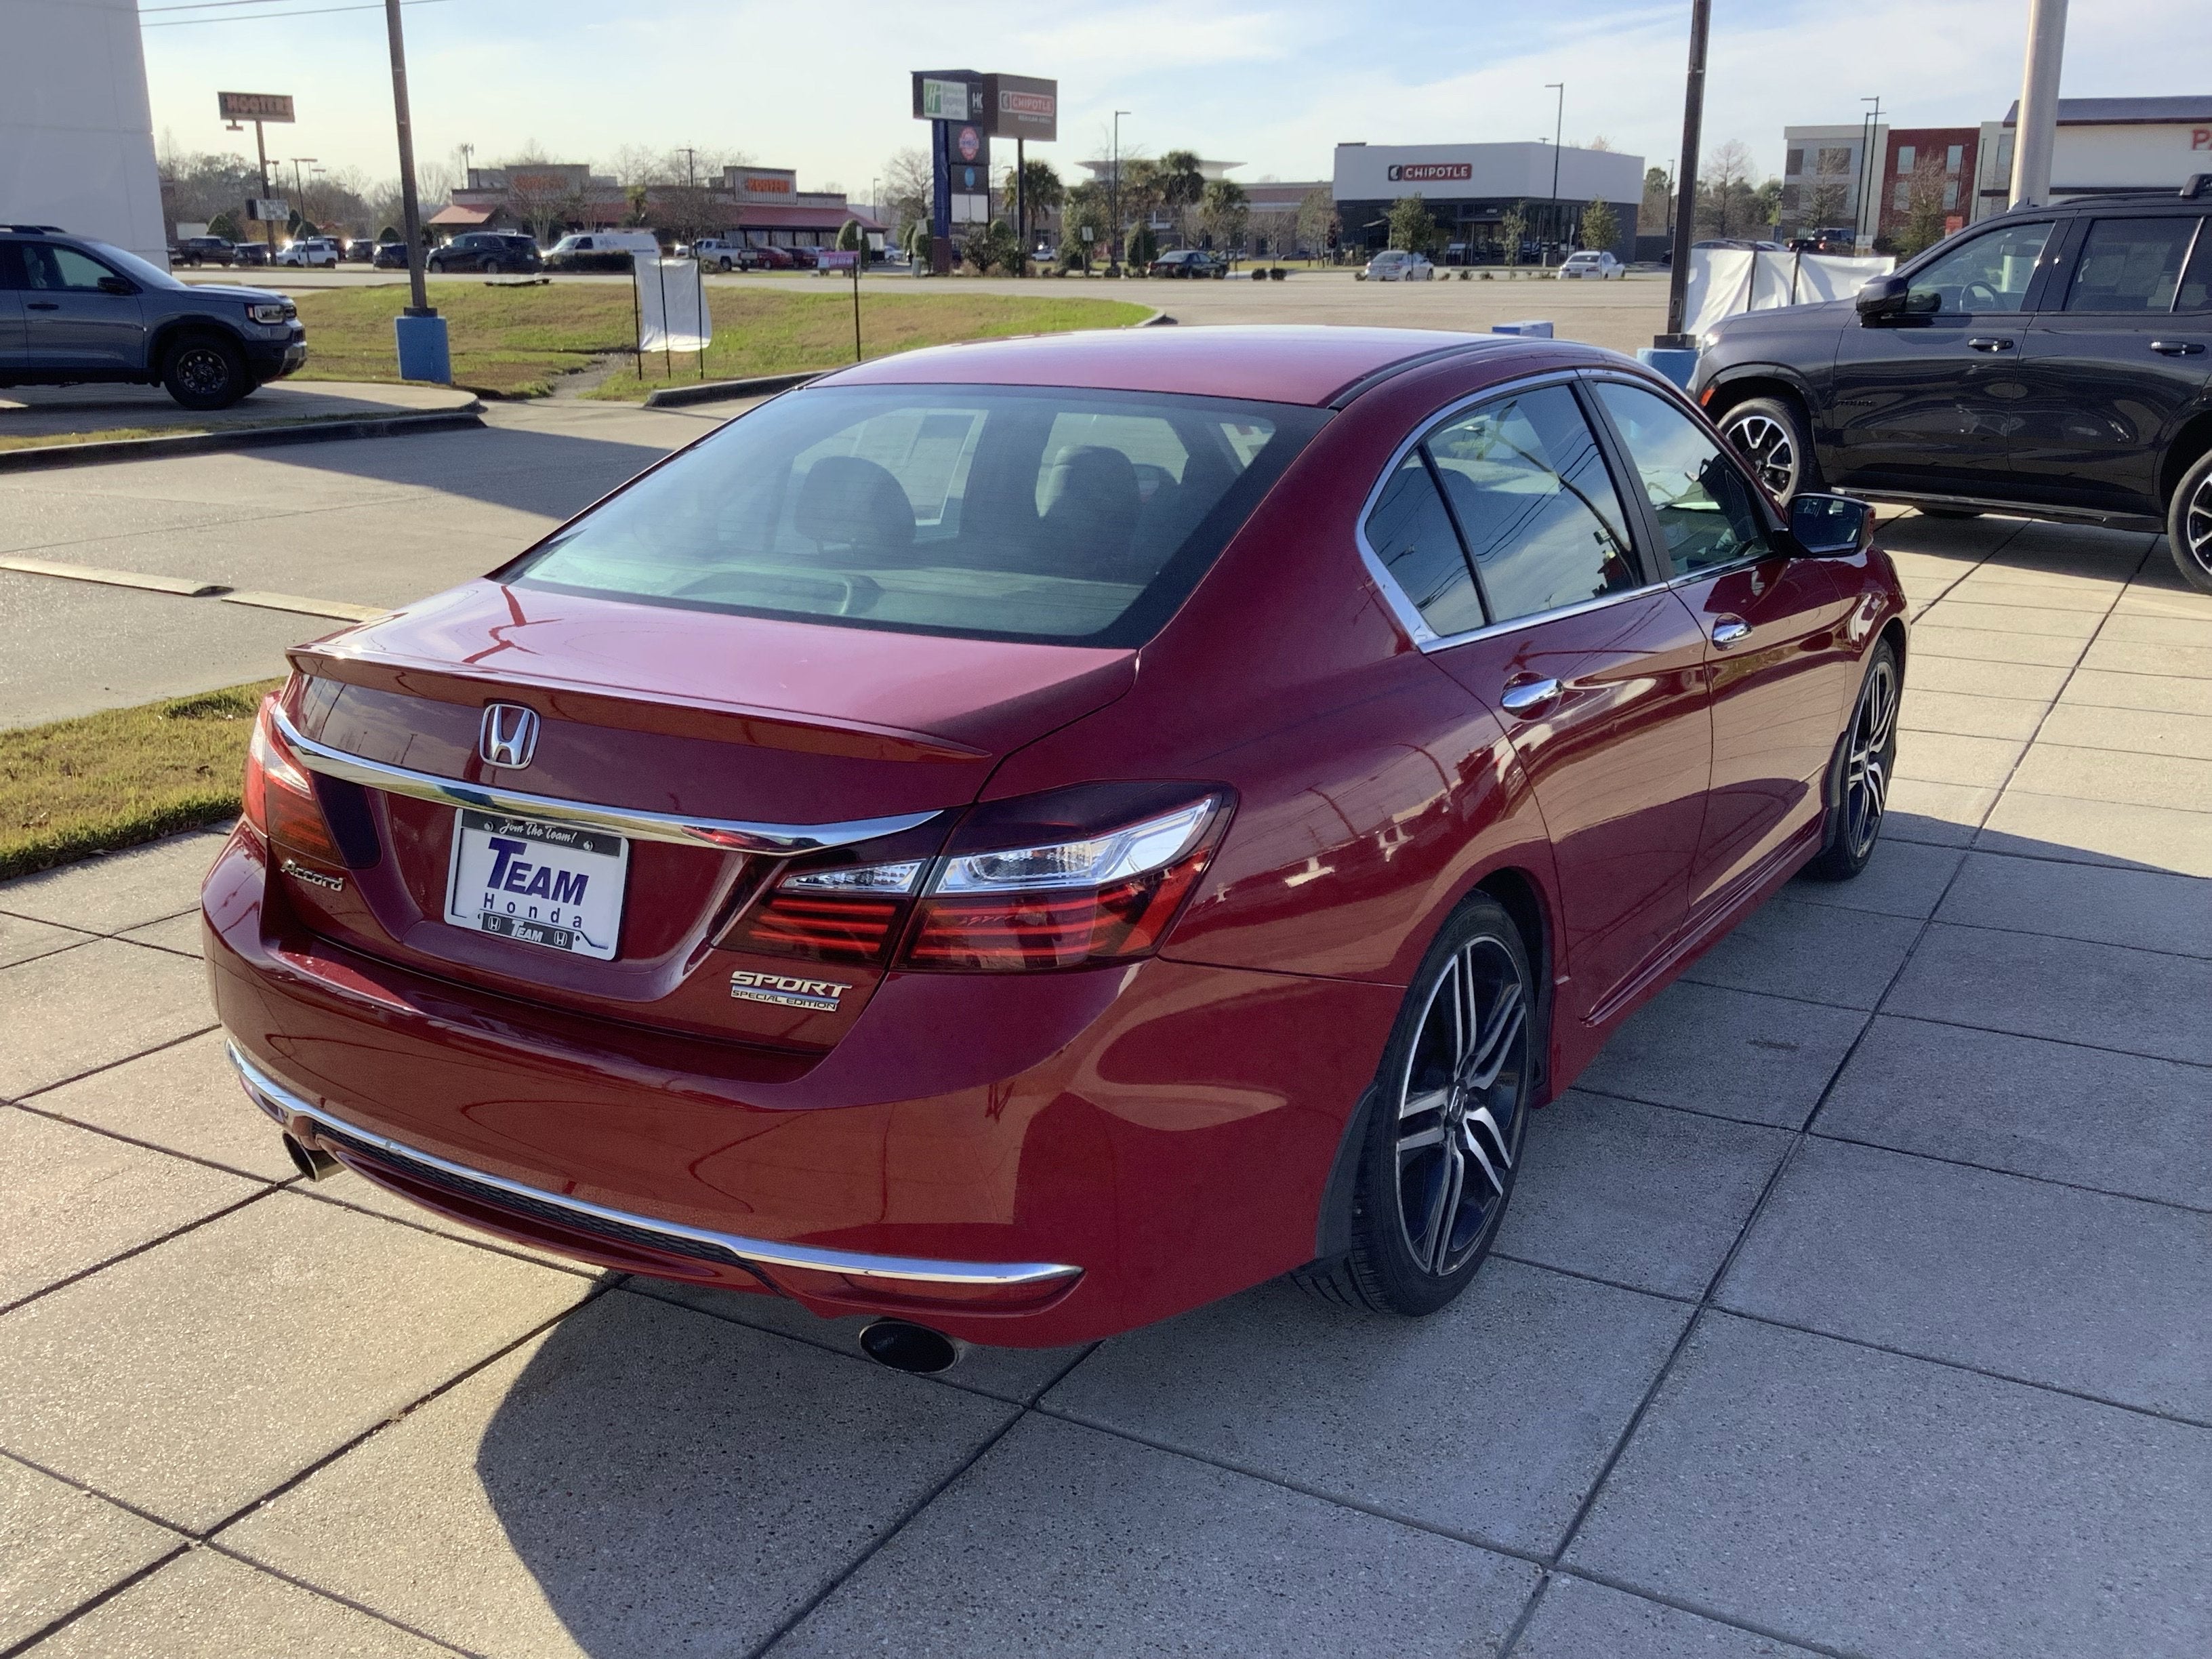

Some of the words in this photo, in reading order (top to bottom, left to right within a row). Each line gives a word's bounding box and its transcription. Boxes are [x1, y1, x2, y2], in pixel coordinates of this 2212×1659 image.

[1012, 96, 1052, 111] CHIPOTLE
[1405, 166, 1468, 178] CHIPOTLE
[499, 818, 525, 834] Join
[545, 825, 578, 844] Team!
[279, 858, 344, 893] Accord
[483, 892, 583, 929] Honda
[729, 970, 853, 998] SPORT
[732, 989, 782, 1003] SPECIAL
[785, 997, 836, 1010] EDITION
